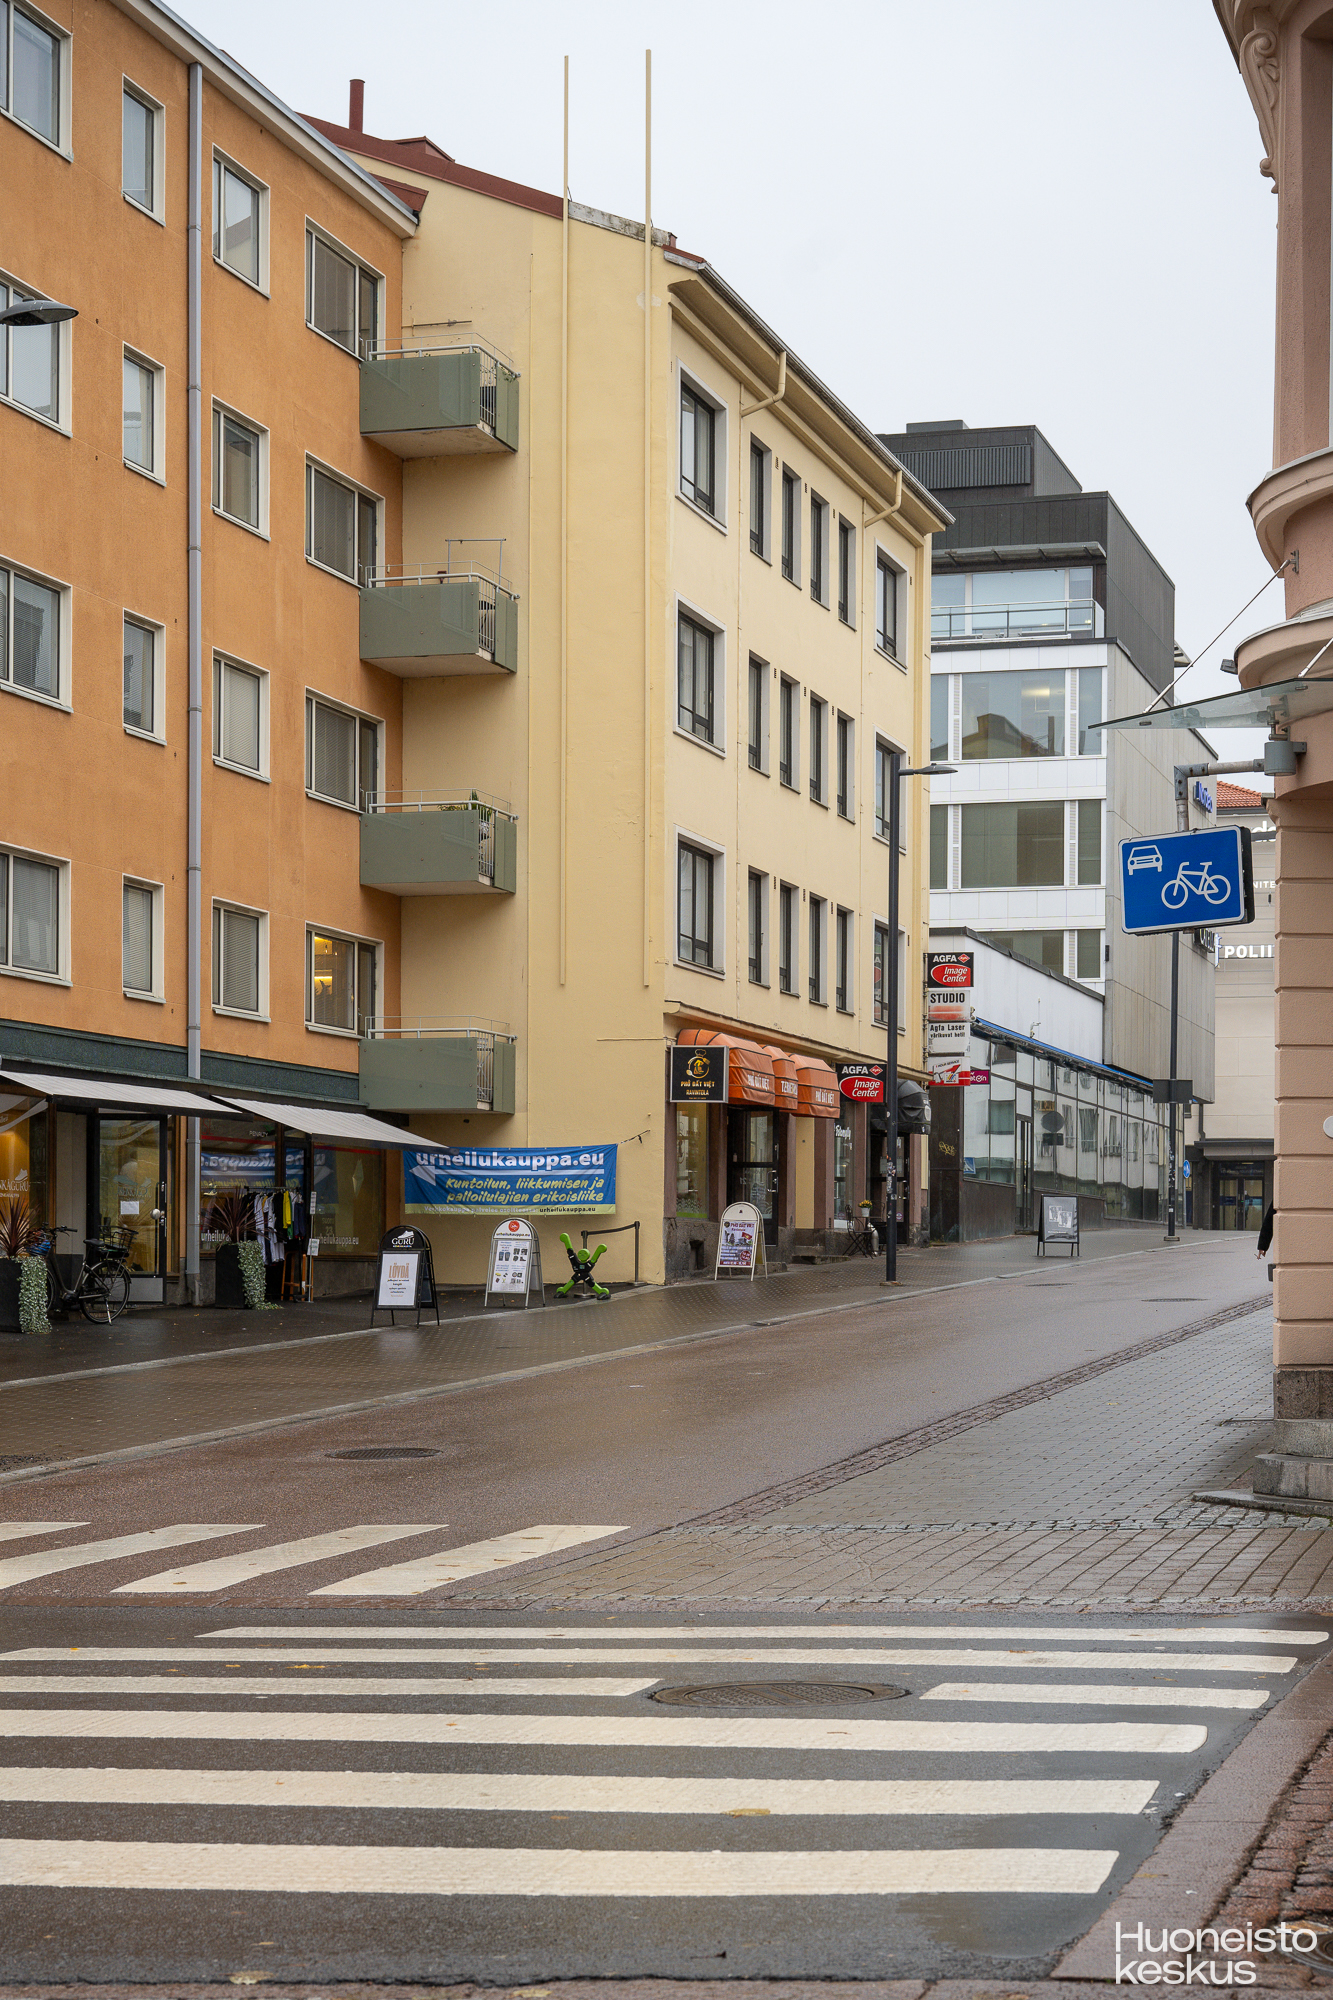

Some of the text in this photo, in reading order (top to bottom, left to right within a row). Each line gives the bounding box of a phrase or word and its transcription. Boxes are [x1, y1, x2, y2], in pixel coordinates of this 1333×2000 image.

[1225, 945, 1272, 959] POLII
[944, 966, 968, 976] Image
[942, 974, 967, 983] Center
[930, 993, 965, 1003] STUDIO
[930, 1024, 944, 1032] Agfa
[842, 1066, 868, 1074] AGFA
[854, 1079, 880, 1090] Image
[852, 1088, 879, 1097] Center
[516, 1178, 588, 1189] liikkumisen
[588, 1177, 604, 1190] ja
[446, 1190, 604, 1205] palloilulajien erikoisliike
[389, 1262, 409, 1278] LÖYDÄ
